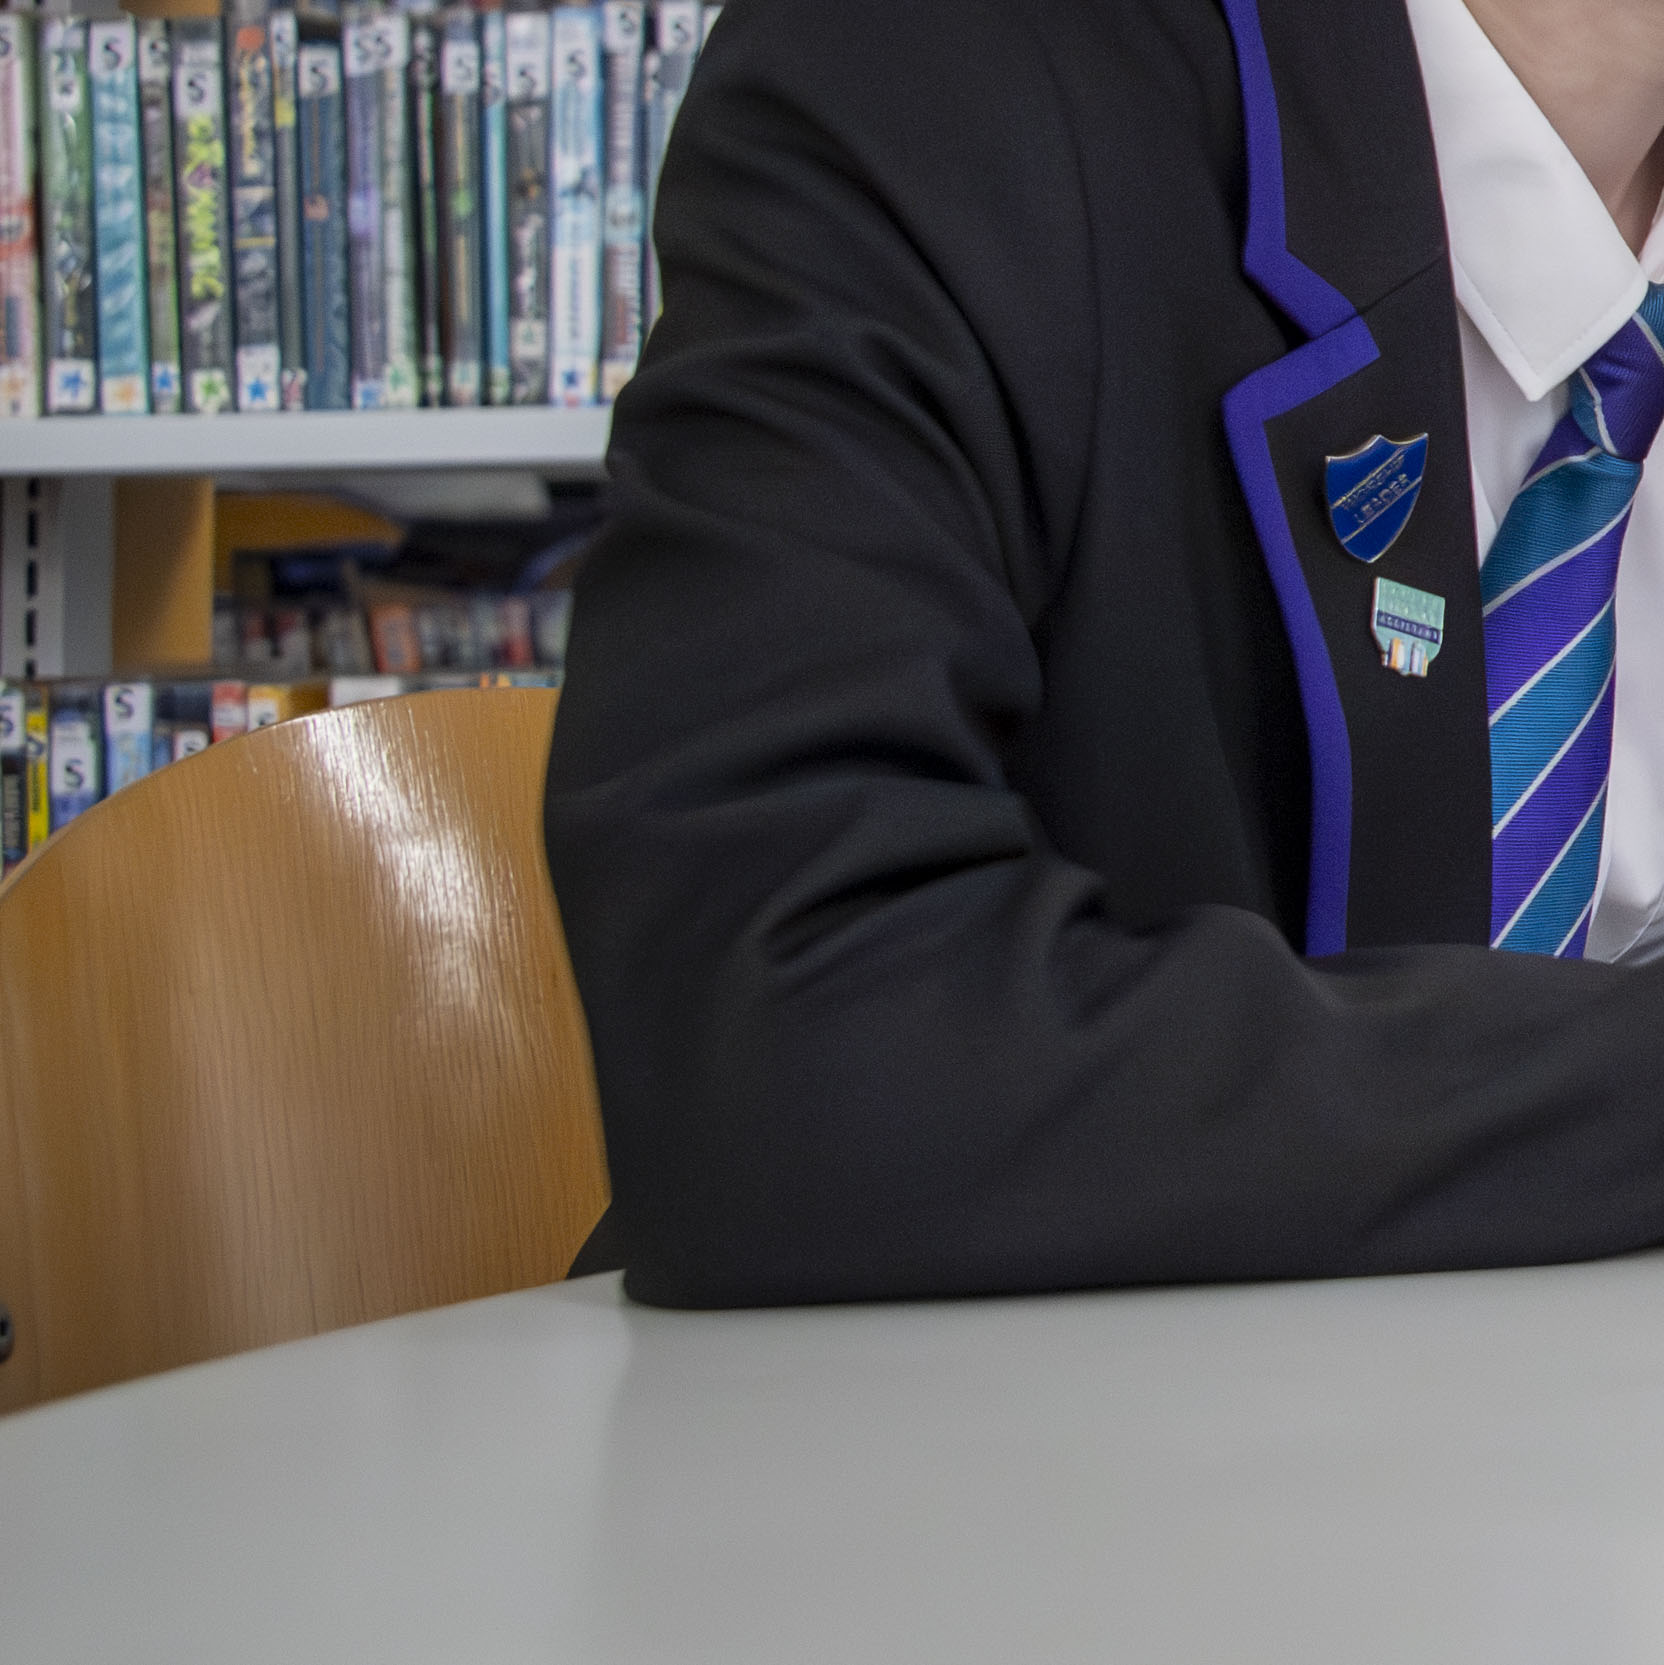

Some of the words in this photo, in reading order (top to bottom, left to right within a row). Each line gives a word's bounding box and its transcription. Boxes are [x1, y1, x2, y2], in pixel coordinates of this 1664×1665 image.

[103, 38, 122, 70] S
[567, 49, 586, 79] S
[187, 73, 205, 103] S
[309, 58, 328, 88] S
[114, 687, 136, 720] S
[64, 757, 84, 788] S
